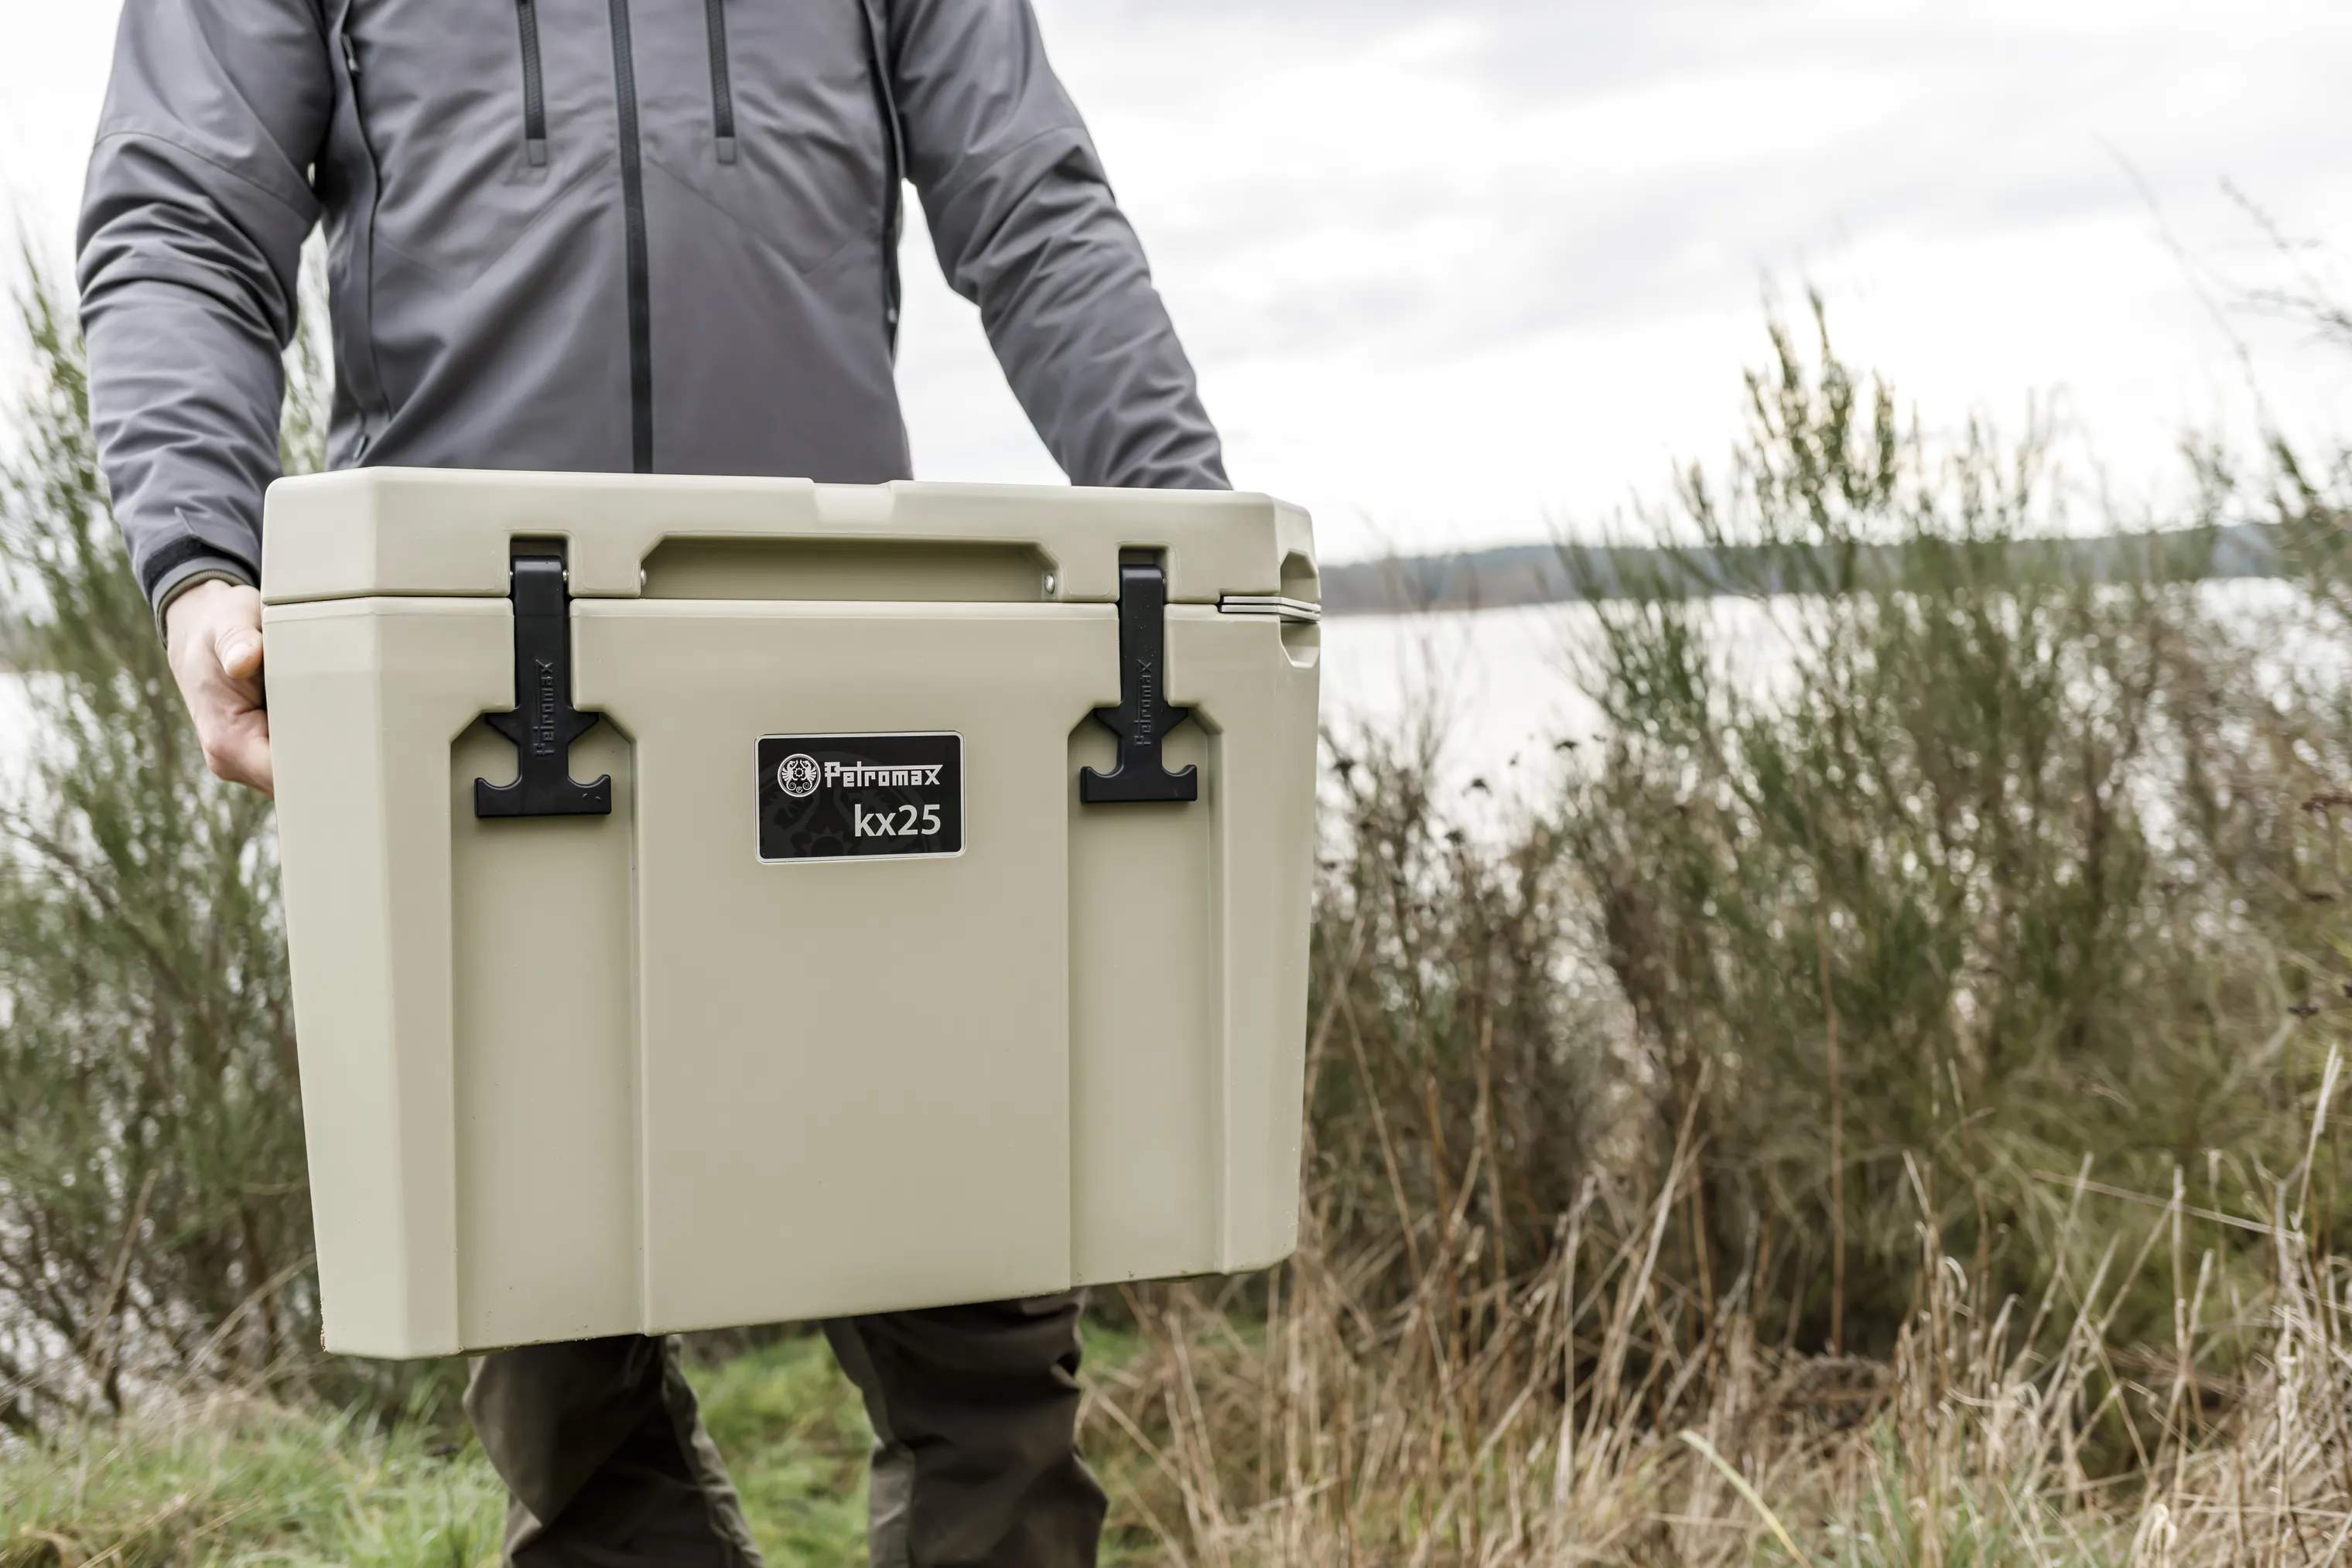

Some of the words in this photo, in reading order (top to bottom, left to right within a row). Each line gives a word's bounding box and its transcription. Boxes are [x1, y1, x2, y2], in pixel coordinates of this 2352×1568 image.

[533, 658, 555, 756] Petromax
[1133, 658, 1152, 746] Petromax
[824, 760, 943, 788] Petromax
[854, 804, 941, 837] kx25
